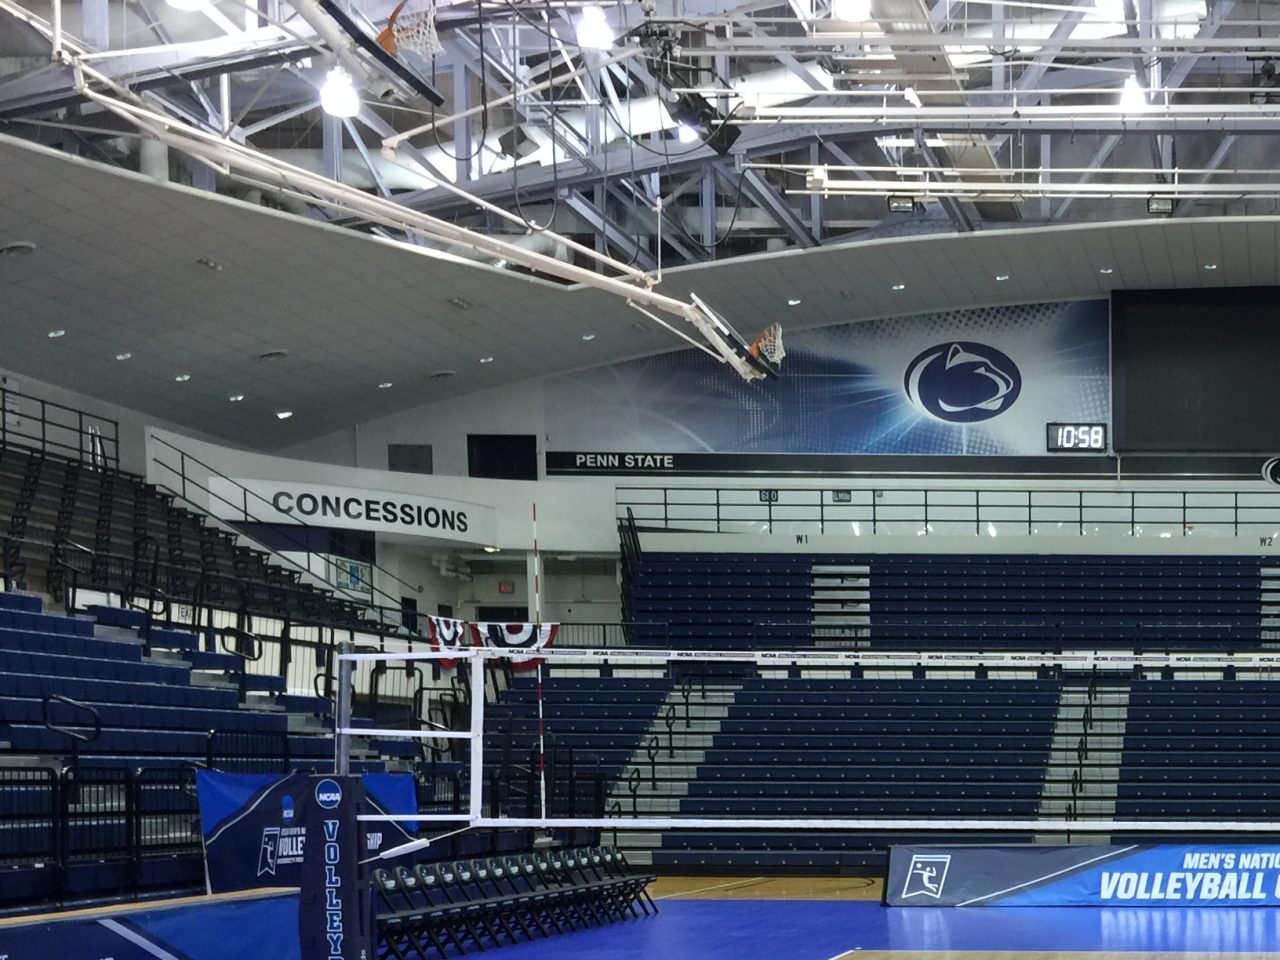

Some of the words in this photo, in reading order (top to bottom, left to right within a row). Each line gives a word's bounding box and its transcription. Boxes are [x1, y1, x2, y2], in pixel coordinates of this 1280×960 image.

[1058, 426, 1103, 448] 10:58
[576, 454, 619, 467] PENN
[624, 455, 674, 467] STATE
[273, 491, 468, 532] CONCESSIONS
[796, 534, 808, 544] W1
[1260, 536, 1273, 547] W2
[319, 792, 341, 801] NCAA
[1183, 853, 1236, 869] MEN'S
[1100, 872, 1266, 900] VOLLEYBALL
